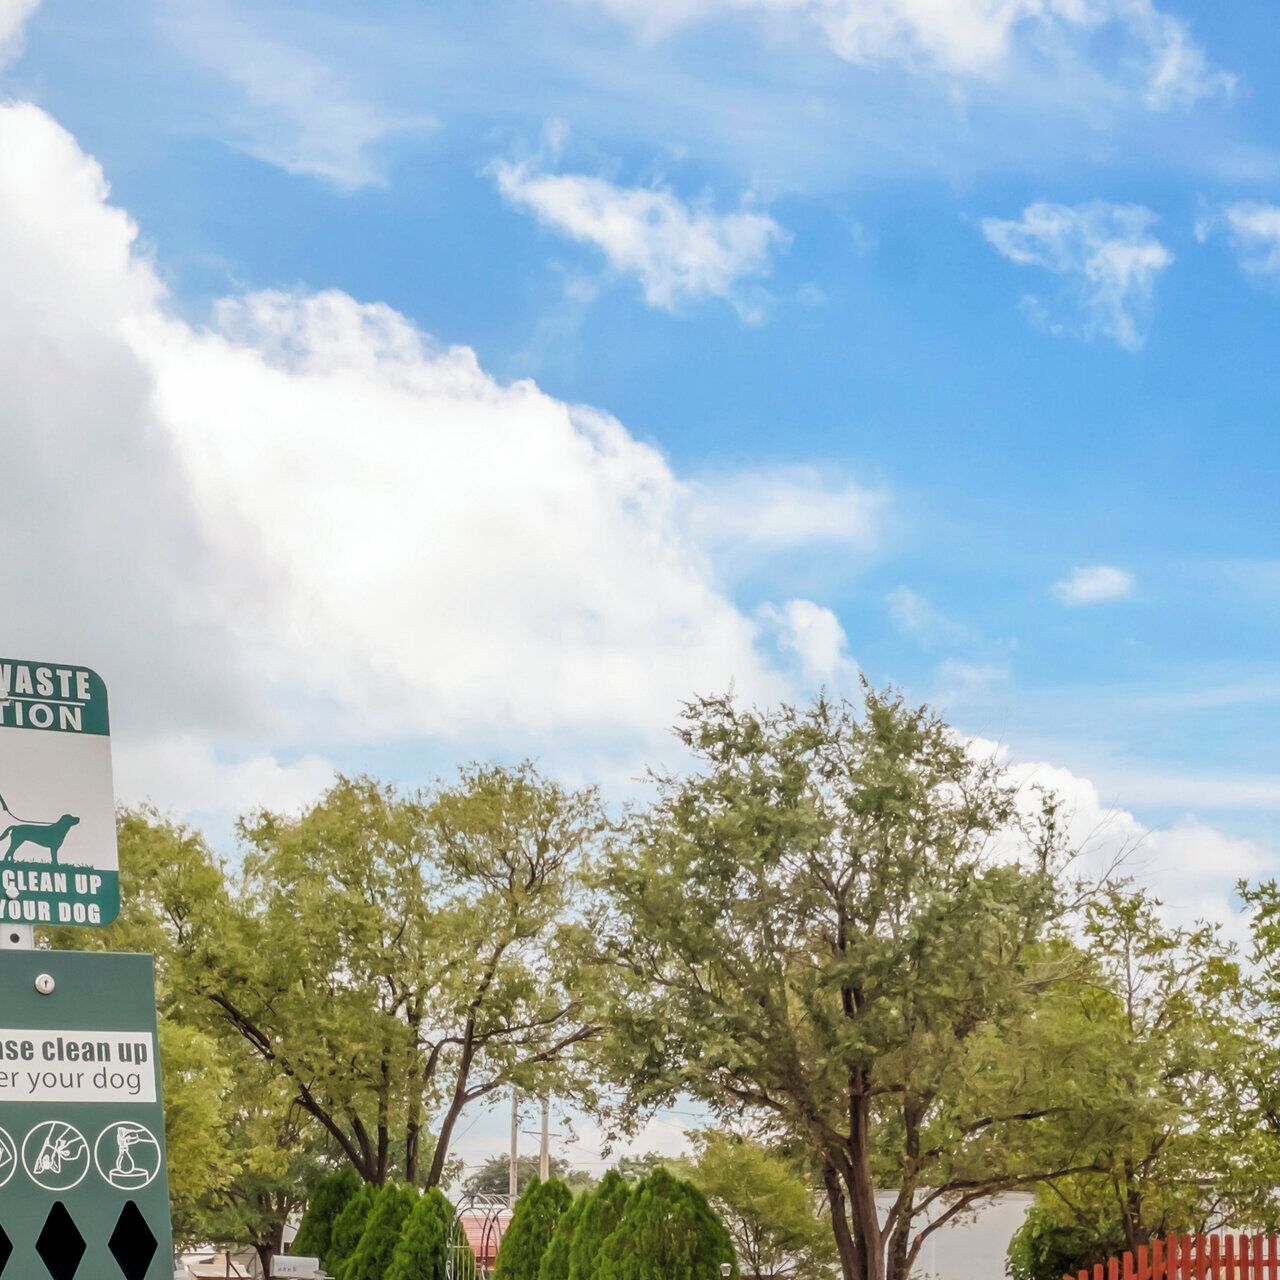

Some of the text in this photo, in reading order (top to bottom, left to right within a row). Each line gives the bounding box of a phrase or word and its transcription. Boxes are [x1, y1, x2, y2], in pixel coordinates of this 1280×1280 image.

[2, 869, 67, 893] CLEAN
[74, 874, 102, 895] UP
[58, 902, 101, 924] DOG
[42, 1037, 111, 1062] clean
[118, 1042, 148, 1065] up
[27, 1071, 84, 1094] your
[93, 1066, 141, 1095] dog
